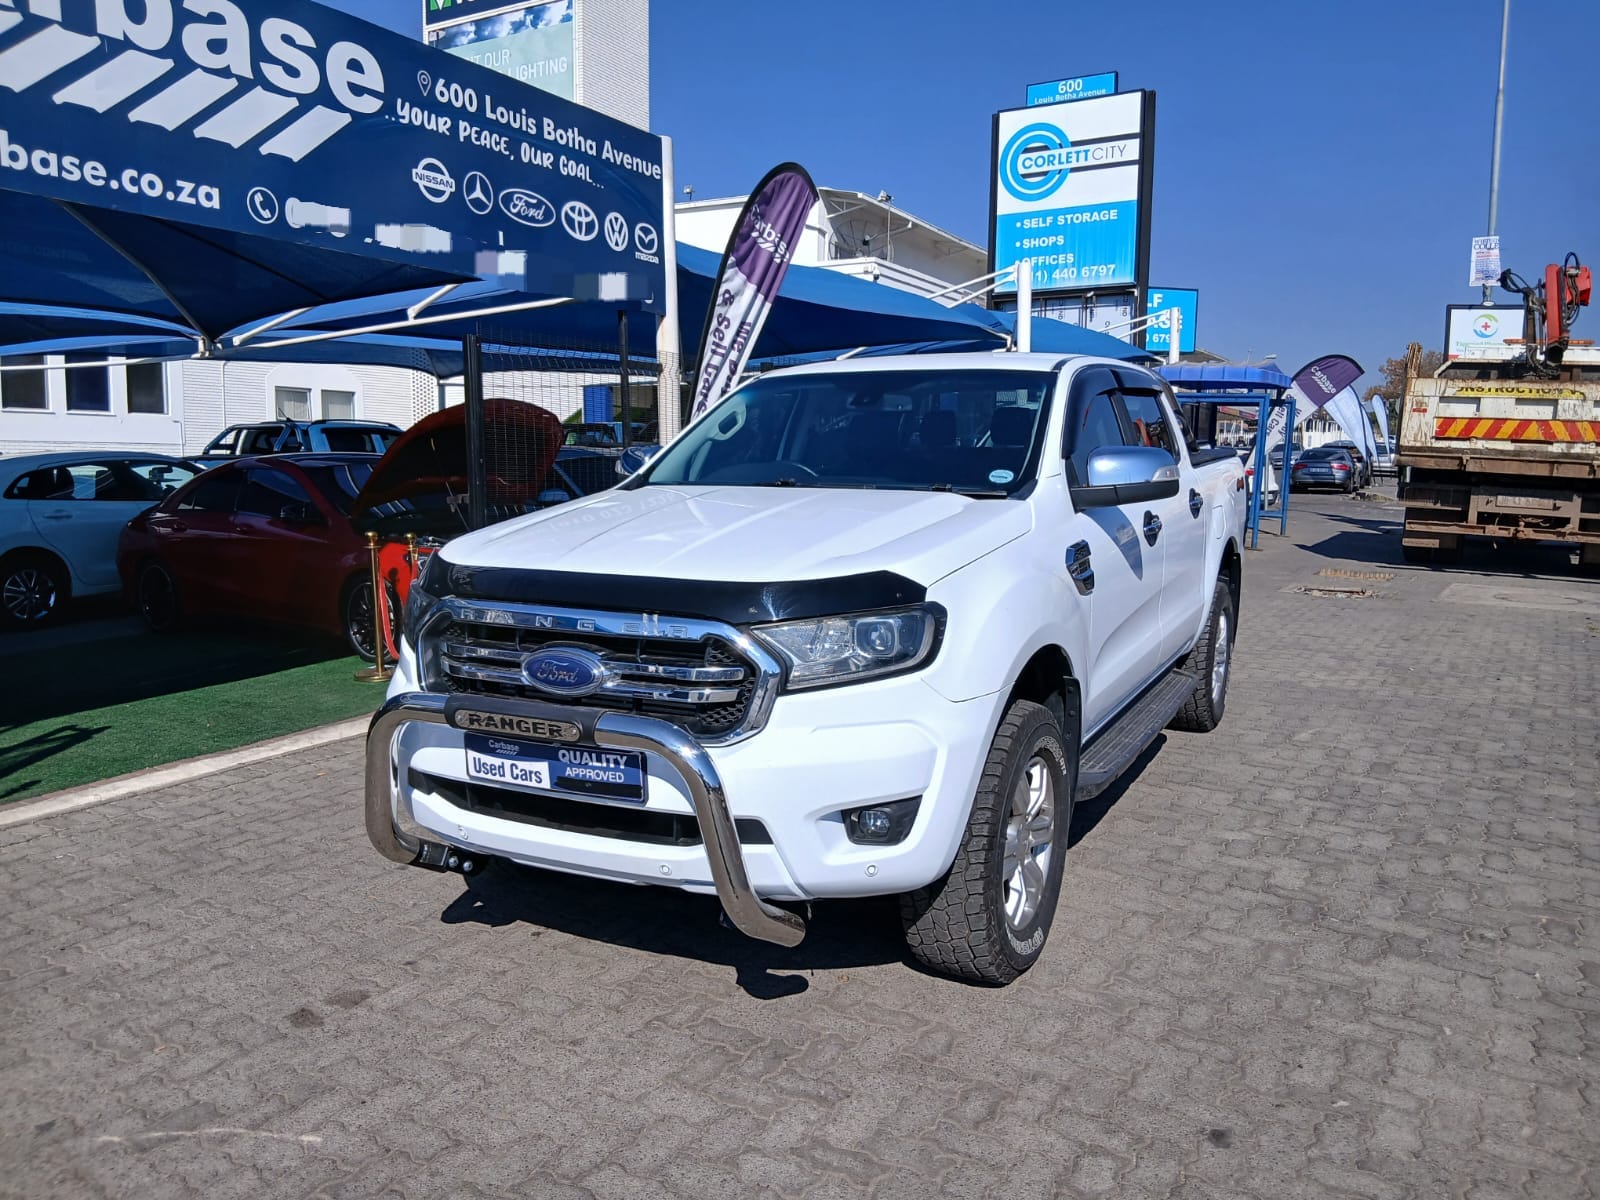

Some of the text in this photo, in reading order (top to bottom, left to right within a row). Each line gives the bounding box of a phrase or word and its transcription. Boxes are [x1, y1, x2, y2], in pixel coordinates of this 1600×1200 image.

[1058, 79, 1083, 94] 600
[1034, 88, 1107, 105] Louis Botha Avenue
[435, 78, 662, 180] 600 Louis Botha Avenue
[459, 119, 514, 160] PEACE,
[520, 142, 554, 169] OUR
[415, 171, 454, 190] NISSAN
[510, 193, 545, 220] Ford
[1023, 210, 1118, 229] SELF STORAGE
[1022, 235, 1065, 249] SHOPS
[1052, 267, 1077, 279] 440
[1081, 264, 1116, 278] 6797
[711, 313, 731, 358] Sell
[1311, 366, 1337, 394] Carbase
[536, 659, 579, 684] Ford
[468, 713, 563, 738] RANGER
[488, 739, 520, 752] Carbase
[558, 750, 627, 769] QUALITY
[473, 757, 543, 784] Used Cars
[565, 767, 625, 783] APPROVED
